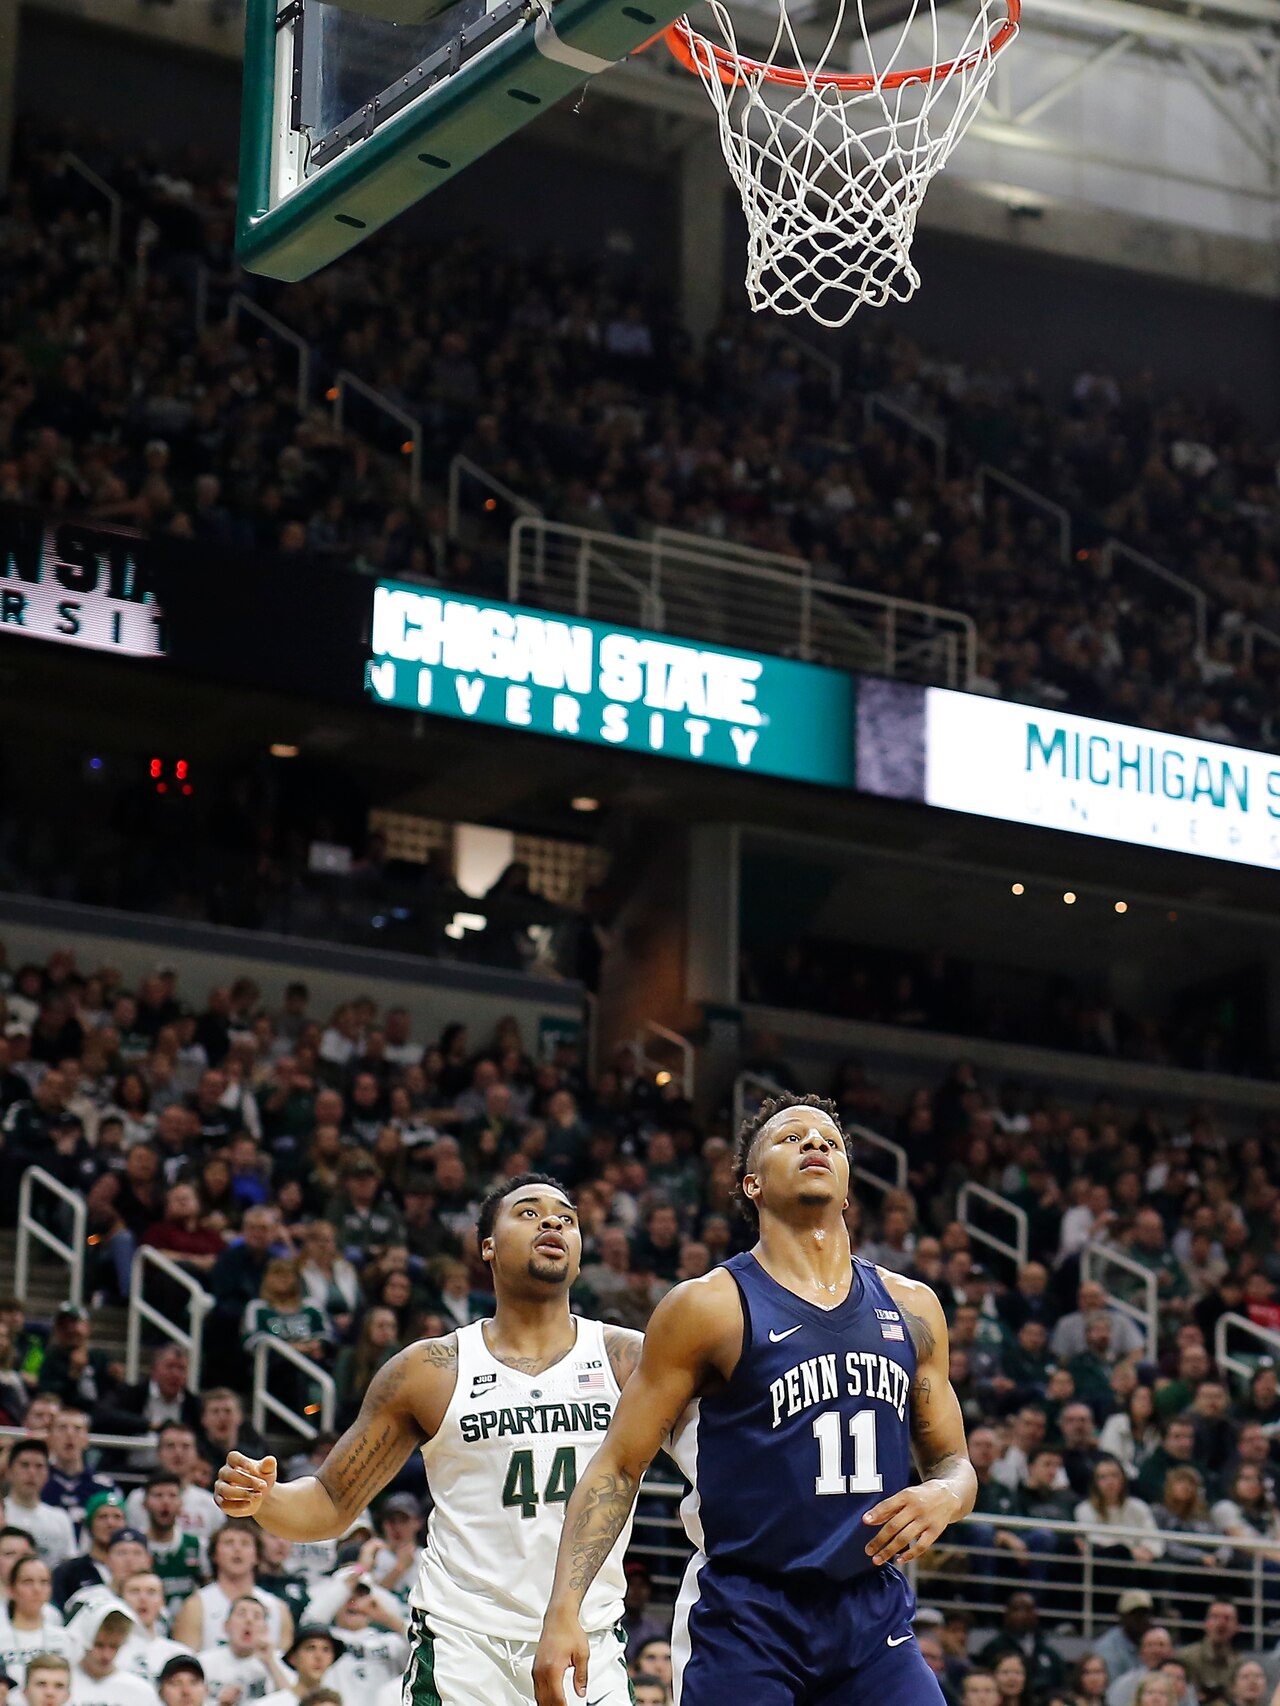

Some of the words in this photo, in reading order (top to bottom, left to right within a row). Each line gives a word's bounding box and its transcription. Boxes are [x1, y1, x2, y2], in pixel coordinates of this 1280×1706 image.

[600, 634, 763, 726] STATE
[1026, 722, 1248, 813] MICHIGAN
[460, 1402, 611, 1443] SPARTANS
[769, 1353, 838, 1429] PENN
[845, 1351, 910, 1422] STATE
[502, 1446, 577, 1519] 44
[812, 1409, 884, 1495] 11
